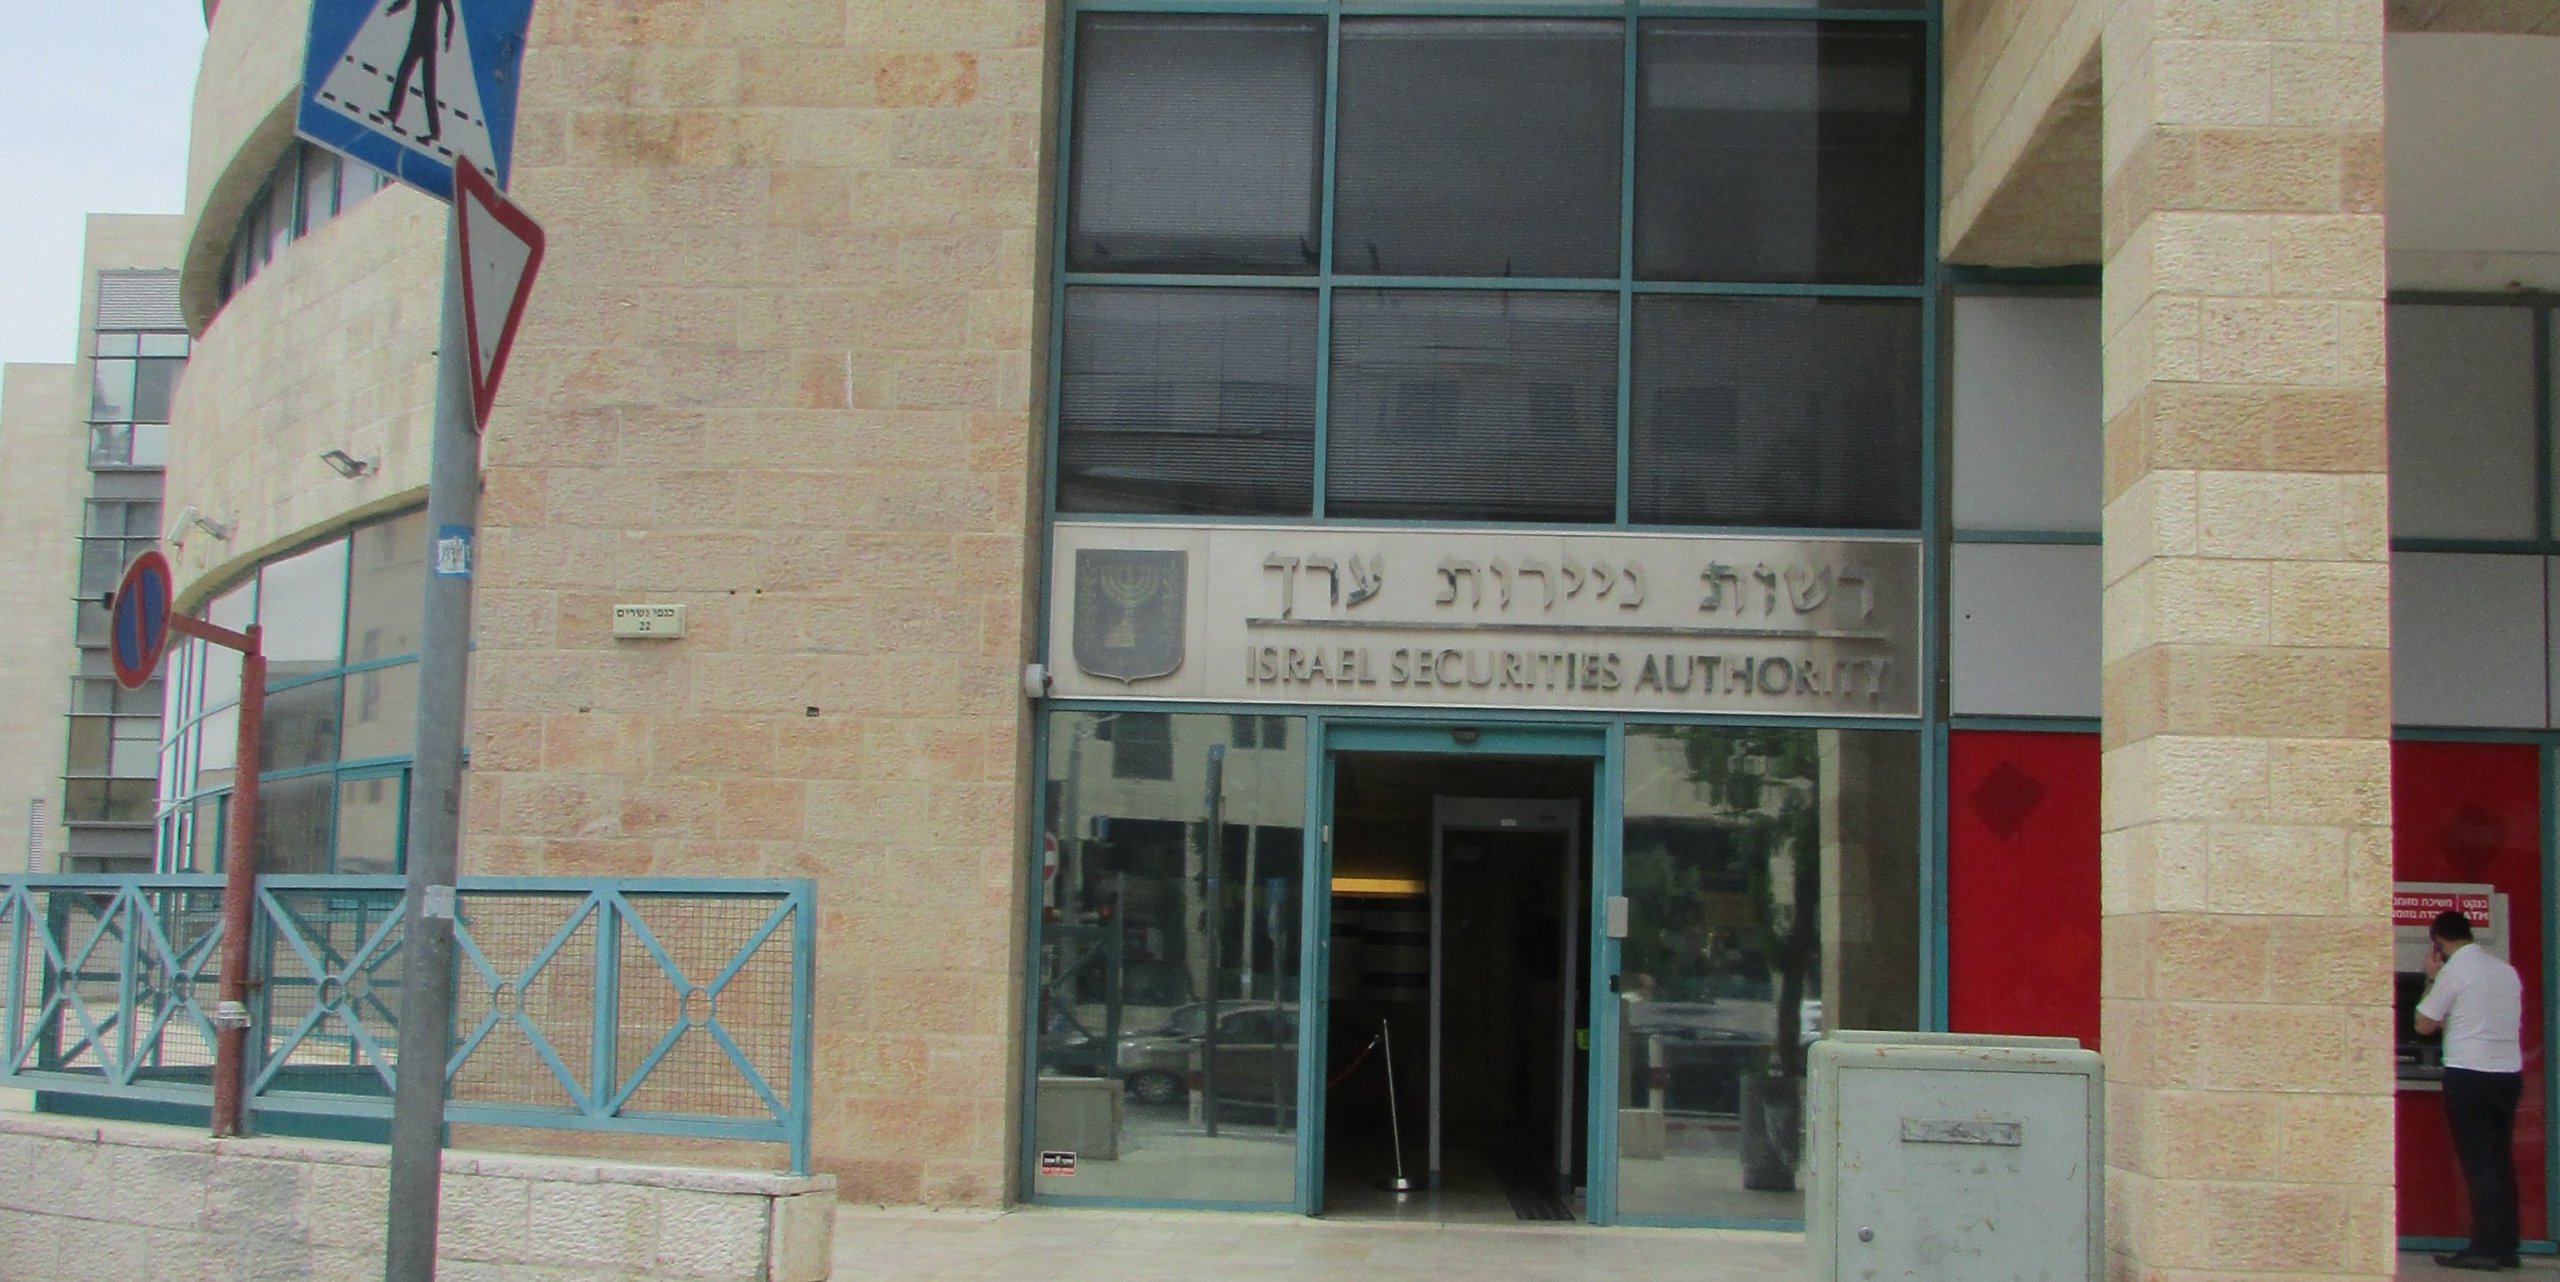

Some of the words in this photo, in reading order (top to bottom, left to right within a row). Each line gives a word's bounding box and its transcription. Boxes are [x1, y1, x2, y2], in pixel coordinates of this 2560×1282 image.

[1263, 551, 1384, 617] ערך
[1435, 555, 1645, 612] ניירות
[1699, 560, 1875, 617] רשות
[616, 608, 650, 618] נשרים
[639, 620, 651, 631] 22
[653, 608, 675, 618] כנפי
[1246, 646, 1377, 685] ISRAEL
[1390, 648, 1622, 691] SECURITIES
[1635, 653, 1889, 696] AUTHORITY
